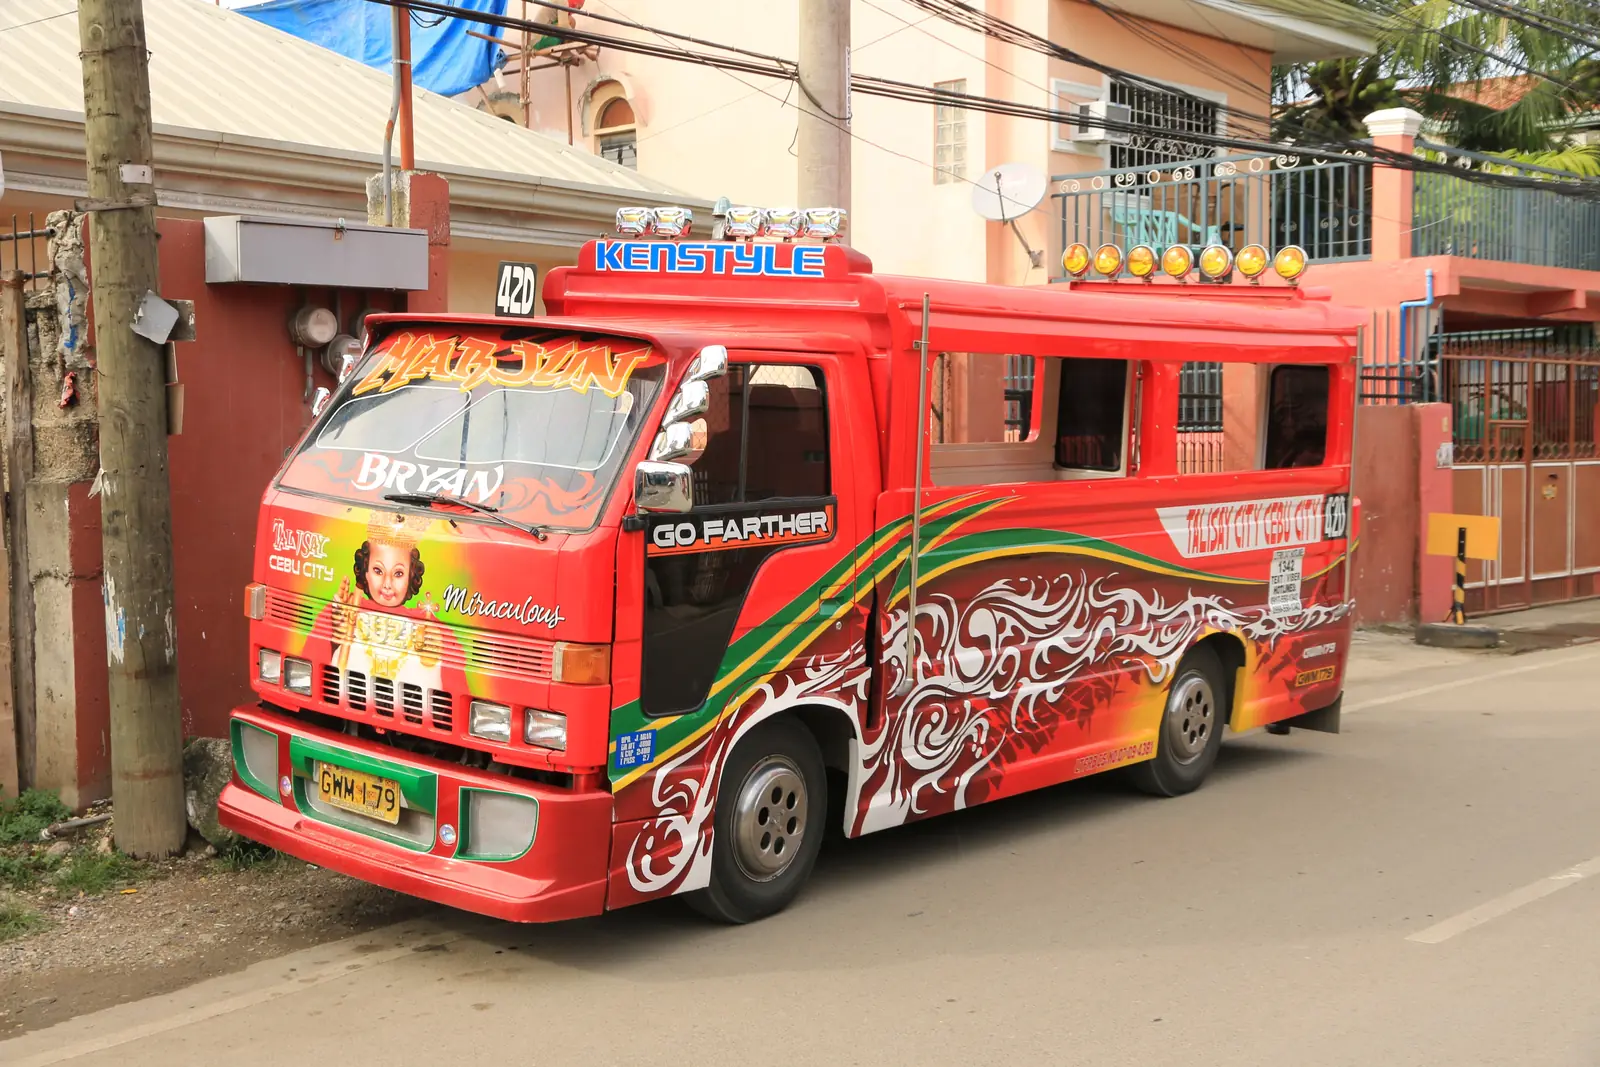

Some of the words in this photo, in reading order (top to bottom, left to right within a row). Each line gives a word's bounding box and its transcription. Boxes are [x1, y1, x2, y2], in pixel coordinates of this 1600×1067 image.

[595, 241, 826, 278] KENSTYLE
[351, 452, 504, 503] BRYAN
[653, 522, 697, 547] GO
[703, 511, 828, 544] FARTHER
[1186, 506, 1234, 554] TALISAY
[1234, 502, 1263, 548] CITY
[1264, 501, 1293, 545] CEBU
[1295, 498, 1321, 541] CITY
[269, 554, 301, 576] CEBU
[303, 561, 334, 582] CITY
[1271, 575, 1283, 585] TEXT
[1278, 560, 1295, 573] 1342
[443, 584, 566, 629] Miraculous
[321, 770, 355, 802] GWM
[361, 783, 396, 812] 179
